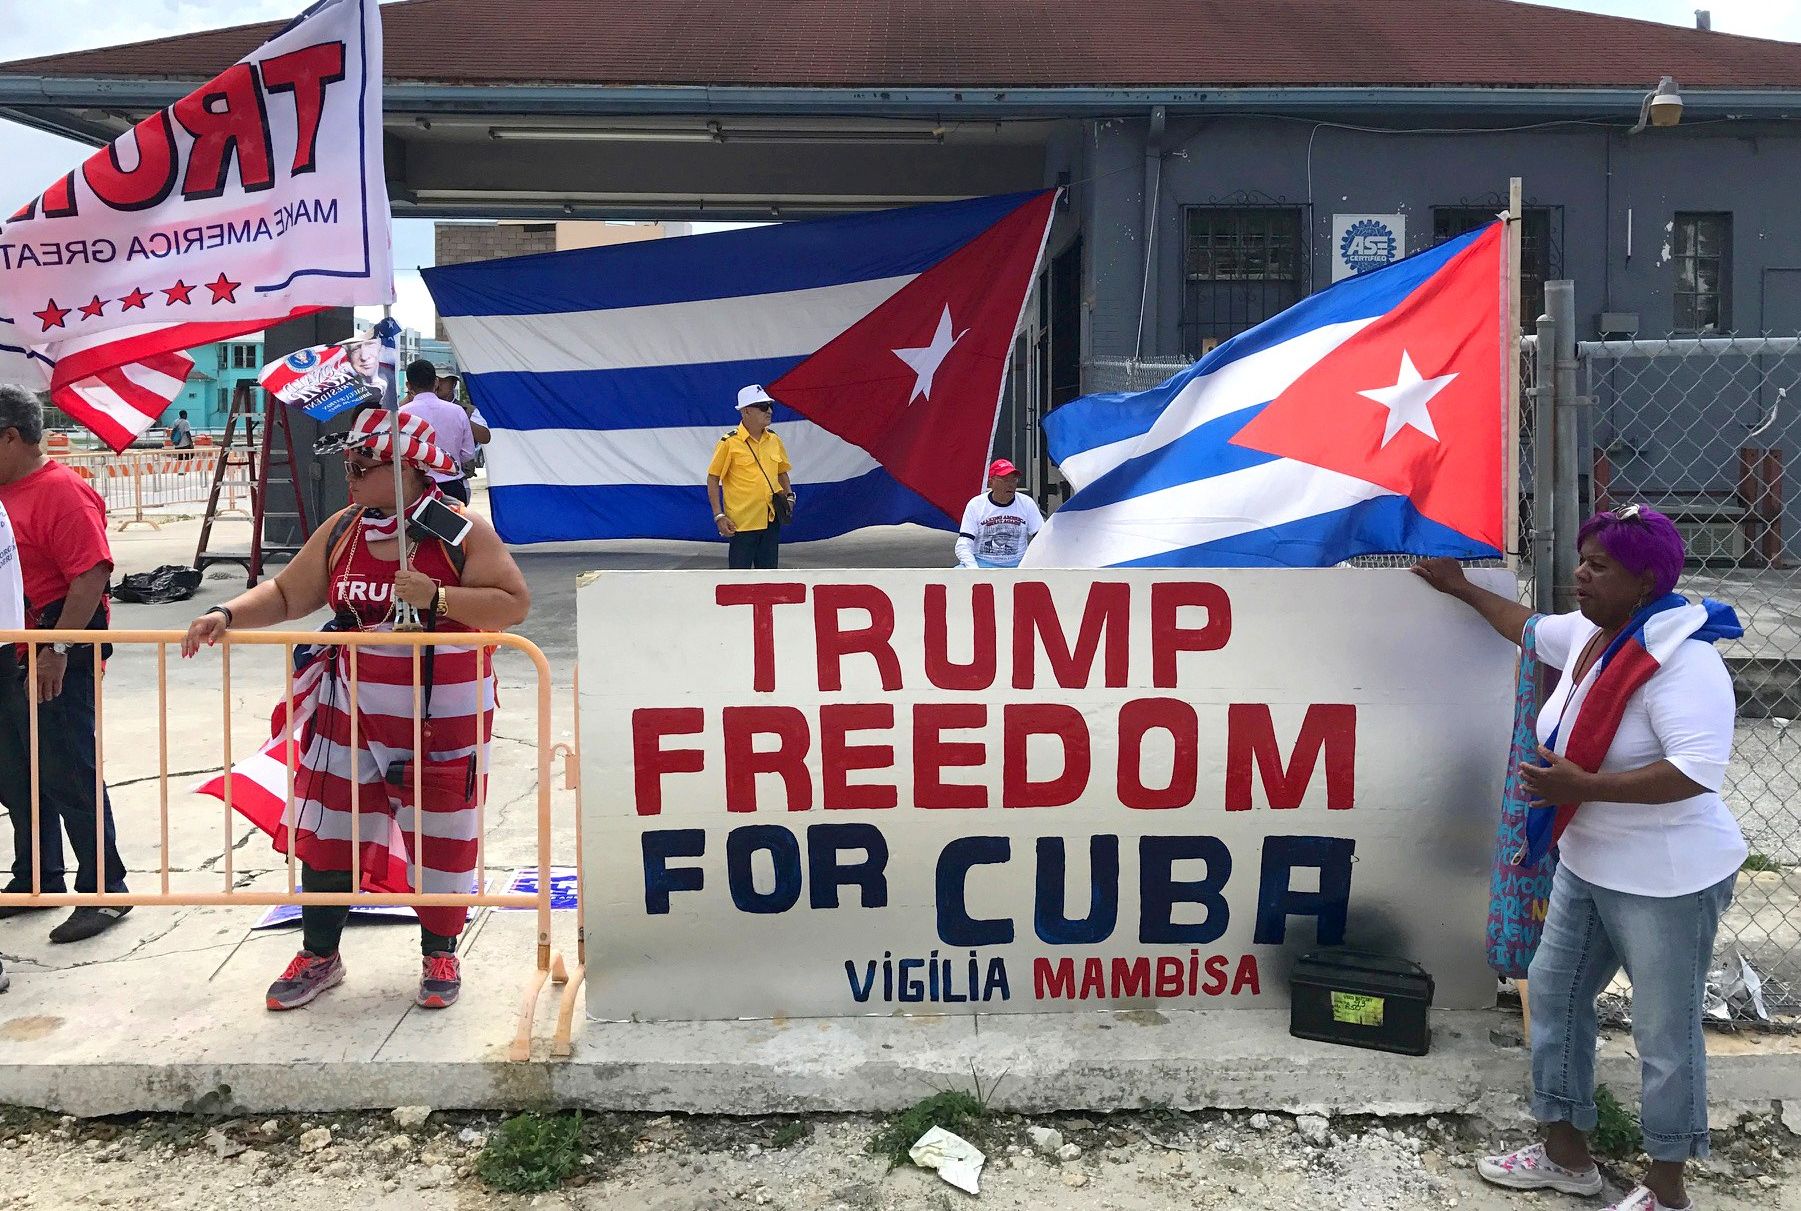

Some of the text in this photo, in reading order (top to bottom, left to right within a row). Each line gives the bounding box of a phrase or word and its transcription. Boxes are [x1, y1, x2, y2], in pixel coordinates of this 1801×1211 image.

[1348, 236, 1388, 255] ASE
[716, 582, 1231, 693] TRUMP
[632, 697, 1357, 812] FREEDOM
[641, 823, 889, 915] FOR
[936, 834, 1356, 945] CUBA
